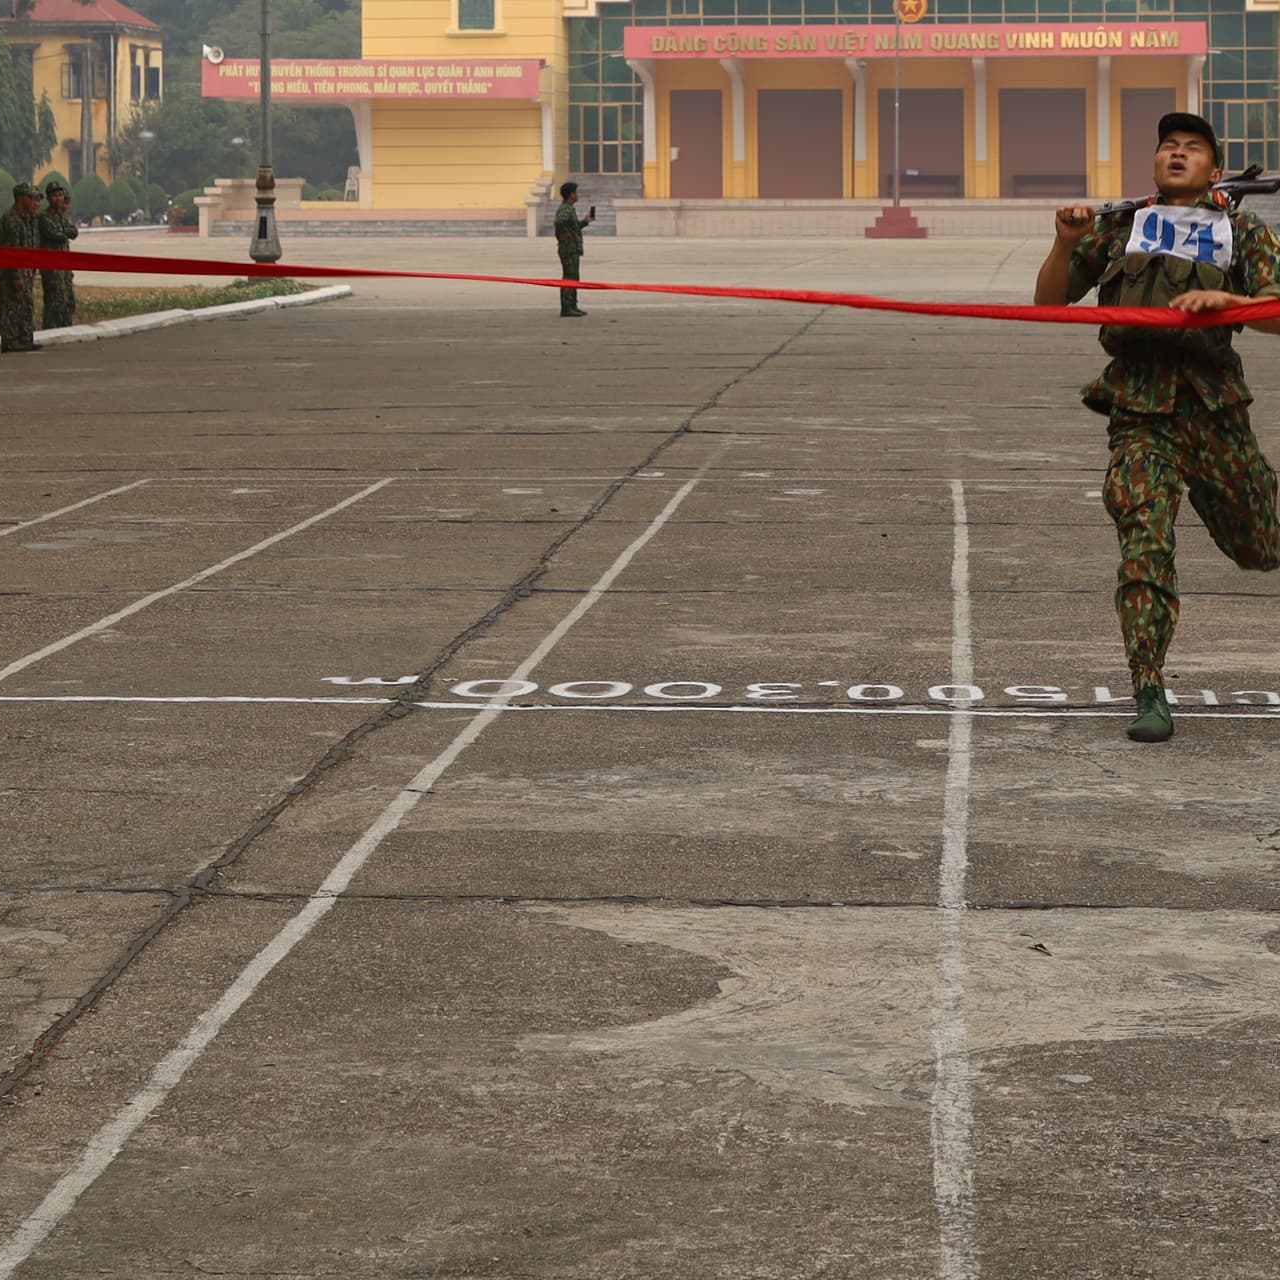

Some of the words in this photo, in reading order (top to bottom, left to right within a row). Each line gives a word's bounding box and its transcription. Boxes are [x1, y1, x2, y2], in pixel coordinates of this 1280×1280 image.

[651, 30, 707, 52] ĐẢNG
[713, 31, 769, 56] CỘNG
[774, 30, 818, 52] SẢN
[825, 28, 868, 55] VIỆT
[874, 32, 923, 51] NAM
[929, 31, 1001, 51] QUANG
[1005, 31, 1055, 50] VINH
[1060, 26, 1123, 50] MUÔN
[1129, 28, 1180, 49] NĂM
[219, 63, 244, 78] PHÁT
[389, 65, 414, 78] QUAN
[437, 63, 463, 78] QUÂN
[473, 65, 494, 78] ANH
[1140, 212, 1224, 263] 94
